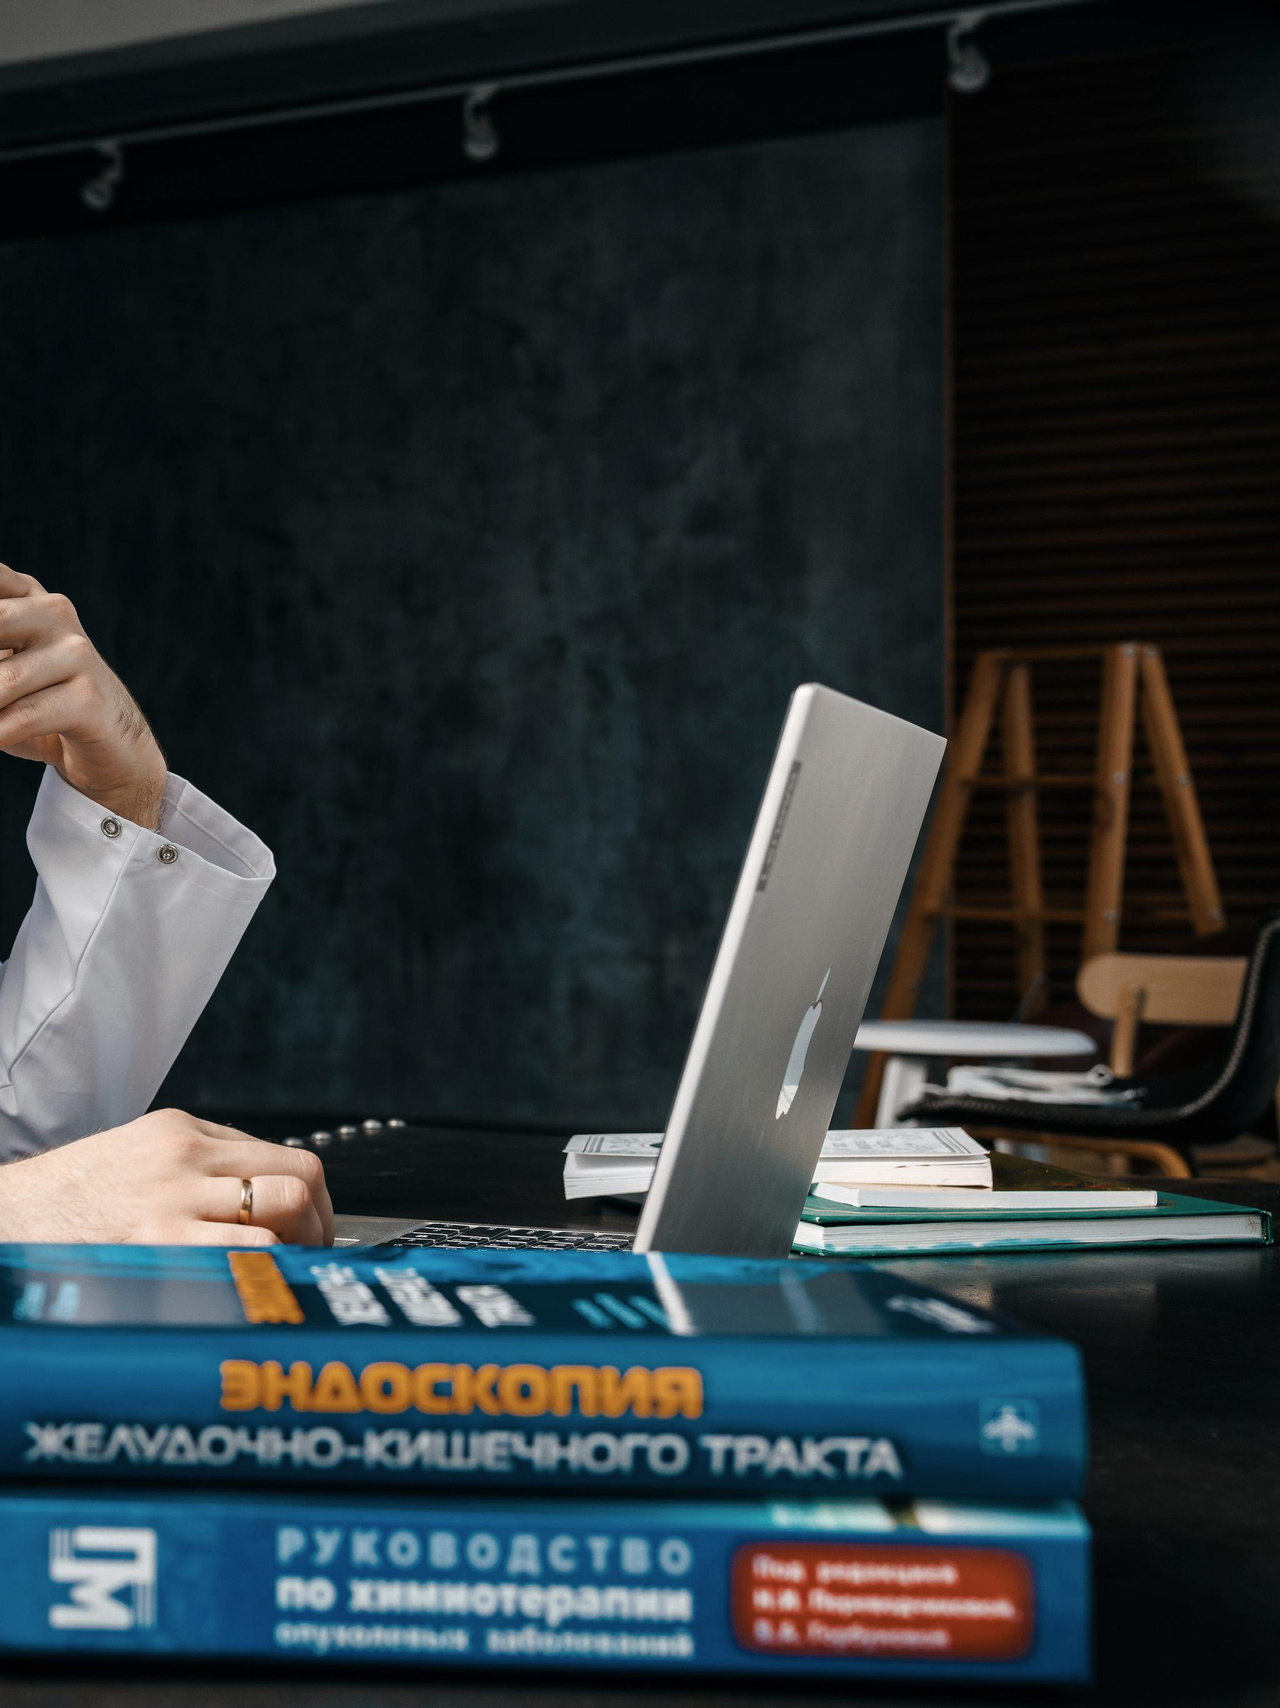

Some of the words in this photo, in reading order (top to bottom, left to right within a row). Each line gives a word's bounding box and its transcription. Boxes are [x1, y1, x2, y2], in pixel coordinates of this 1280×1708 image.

[220, 1360, 703, 1419] ЭНДОСКОПИЯ
[25, 1423, 690, 1475] ЖЕЛУДОЧНО-КИШЕЧНОГО
[700, 1433, 904, 1479] ТРАКТА
[277, 1527, 693, 1576] РУКОВОДСТВО
[350, 1579, 693, 1627] химиотерапии
